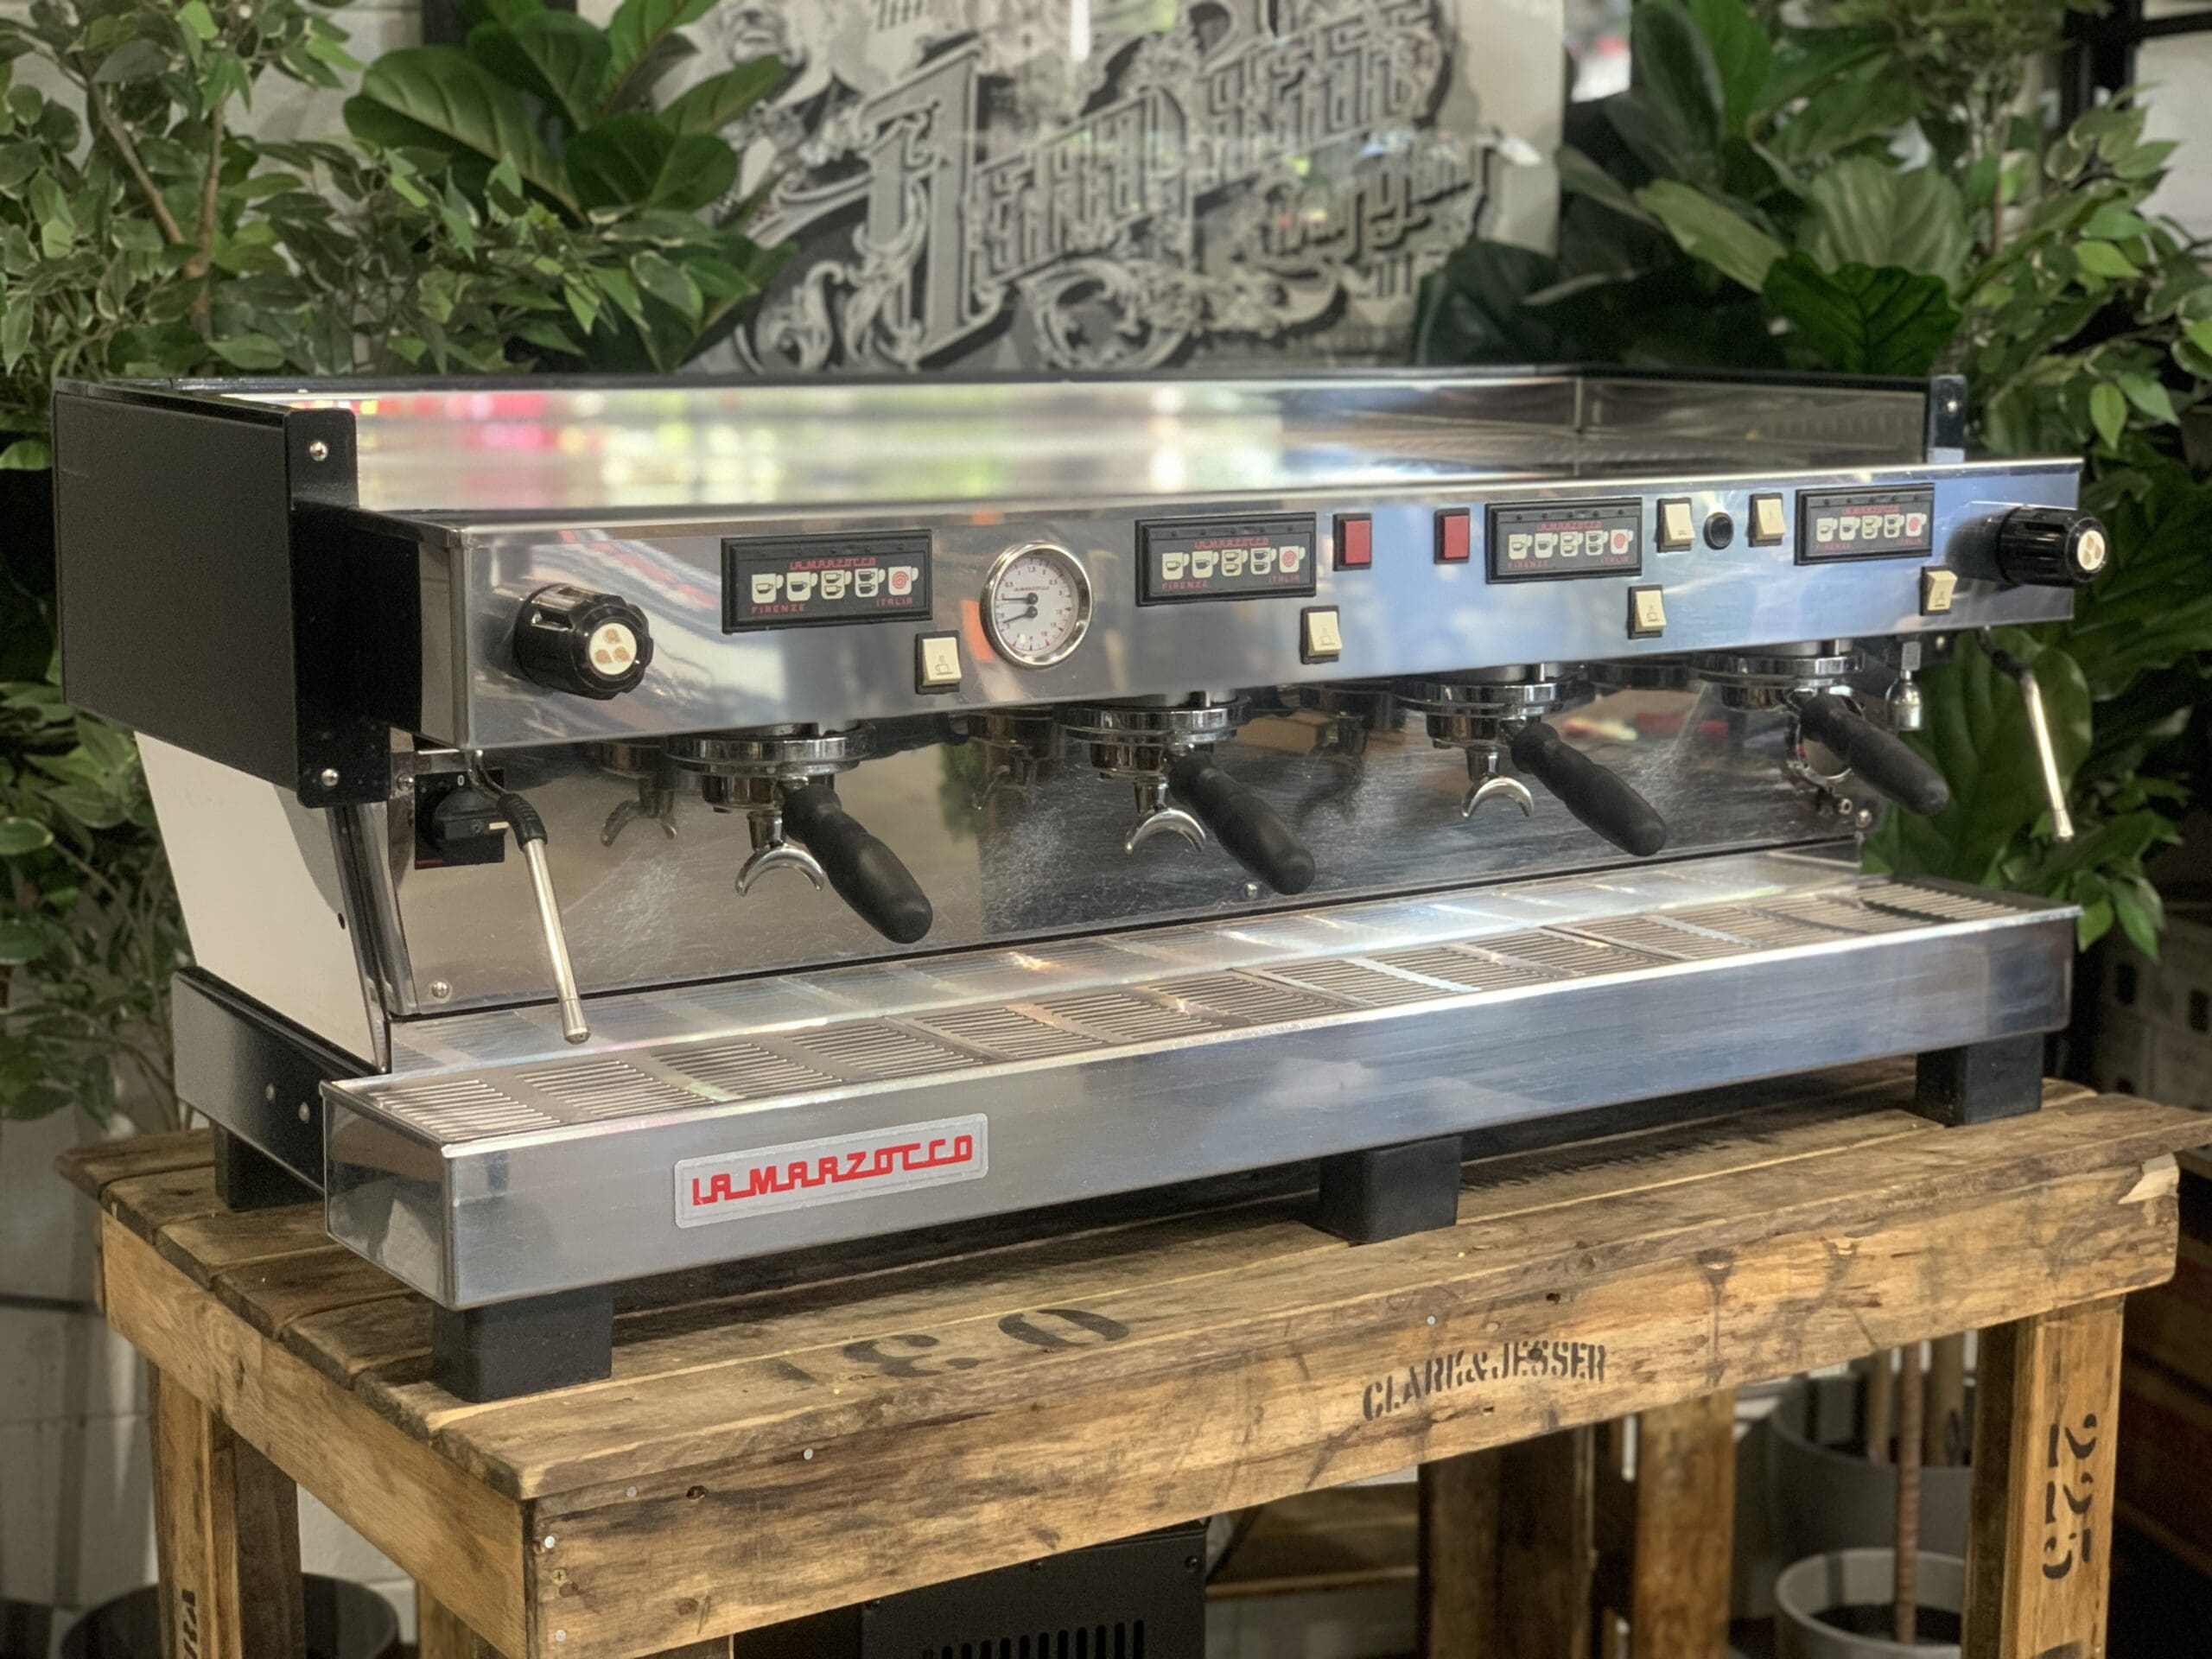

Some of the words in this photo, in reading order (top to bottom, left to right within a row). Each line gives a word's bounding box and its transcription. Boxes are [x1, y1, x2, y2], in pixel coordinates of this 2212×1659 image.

[752, 603, 806, 614] FIRENZE
[876, 597, 912, 607] ITALIA
[693, 1173, 732, 1206] LA
[749, 1135, 973, 1195] MARZOCCO
[2043, 1413, 2097, 1580] 225
